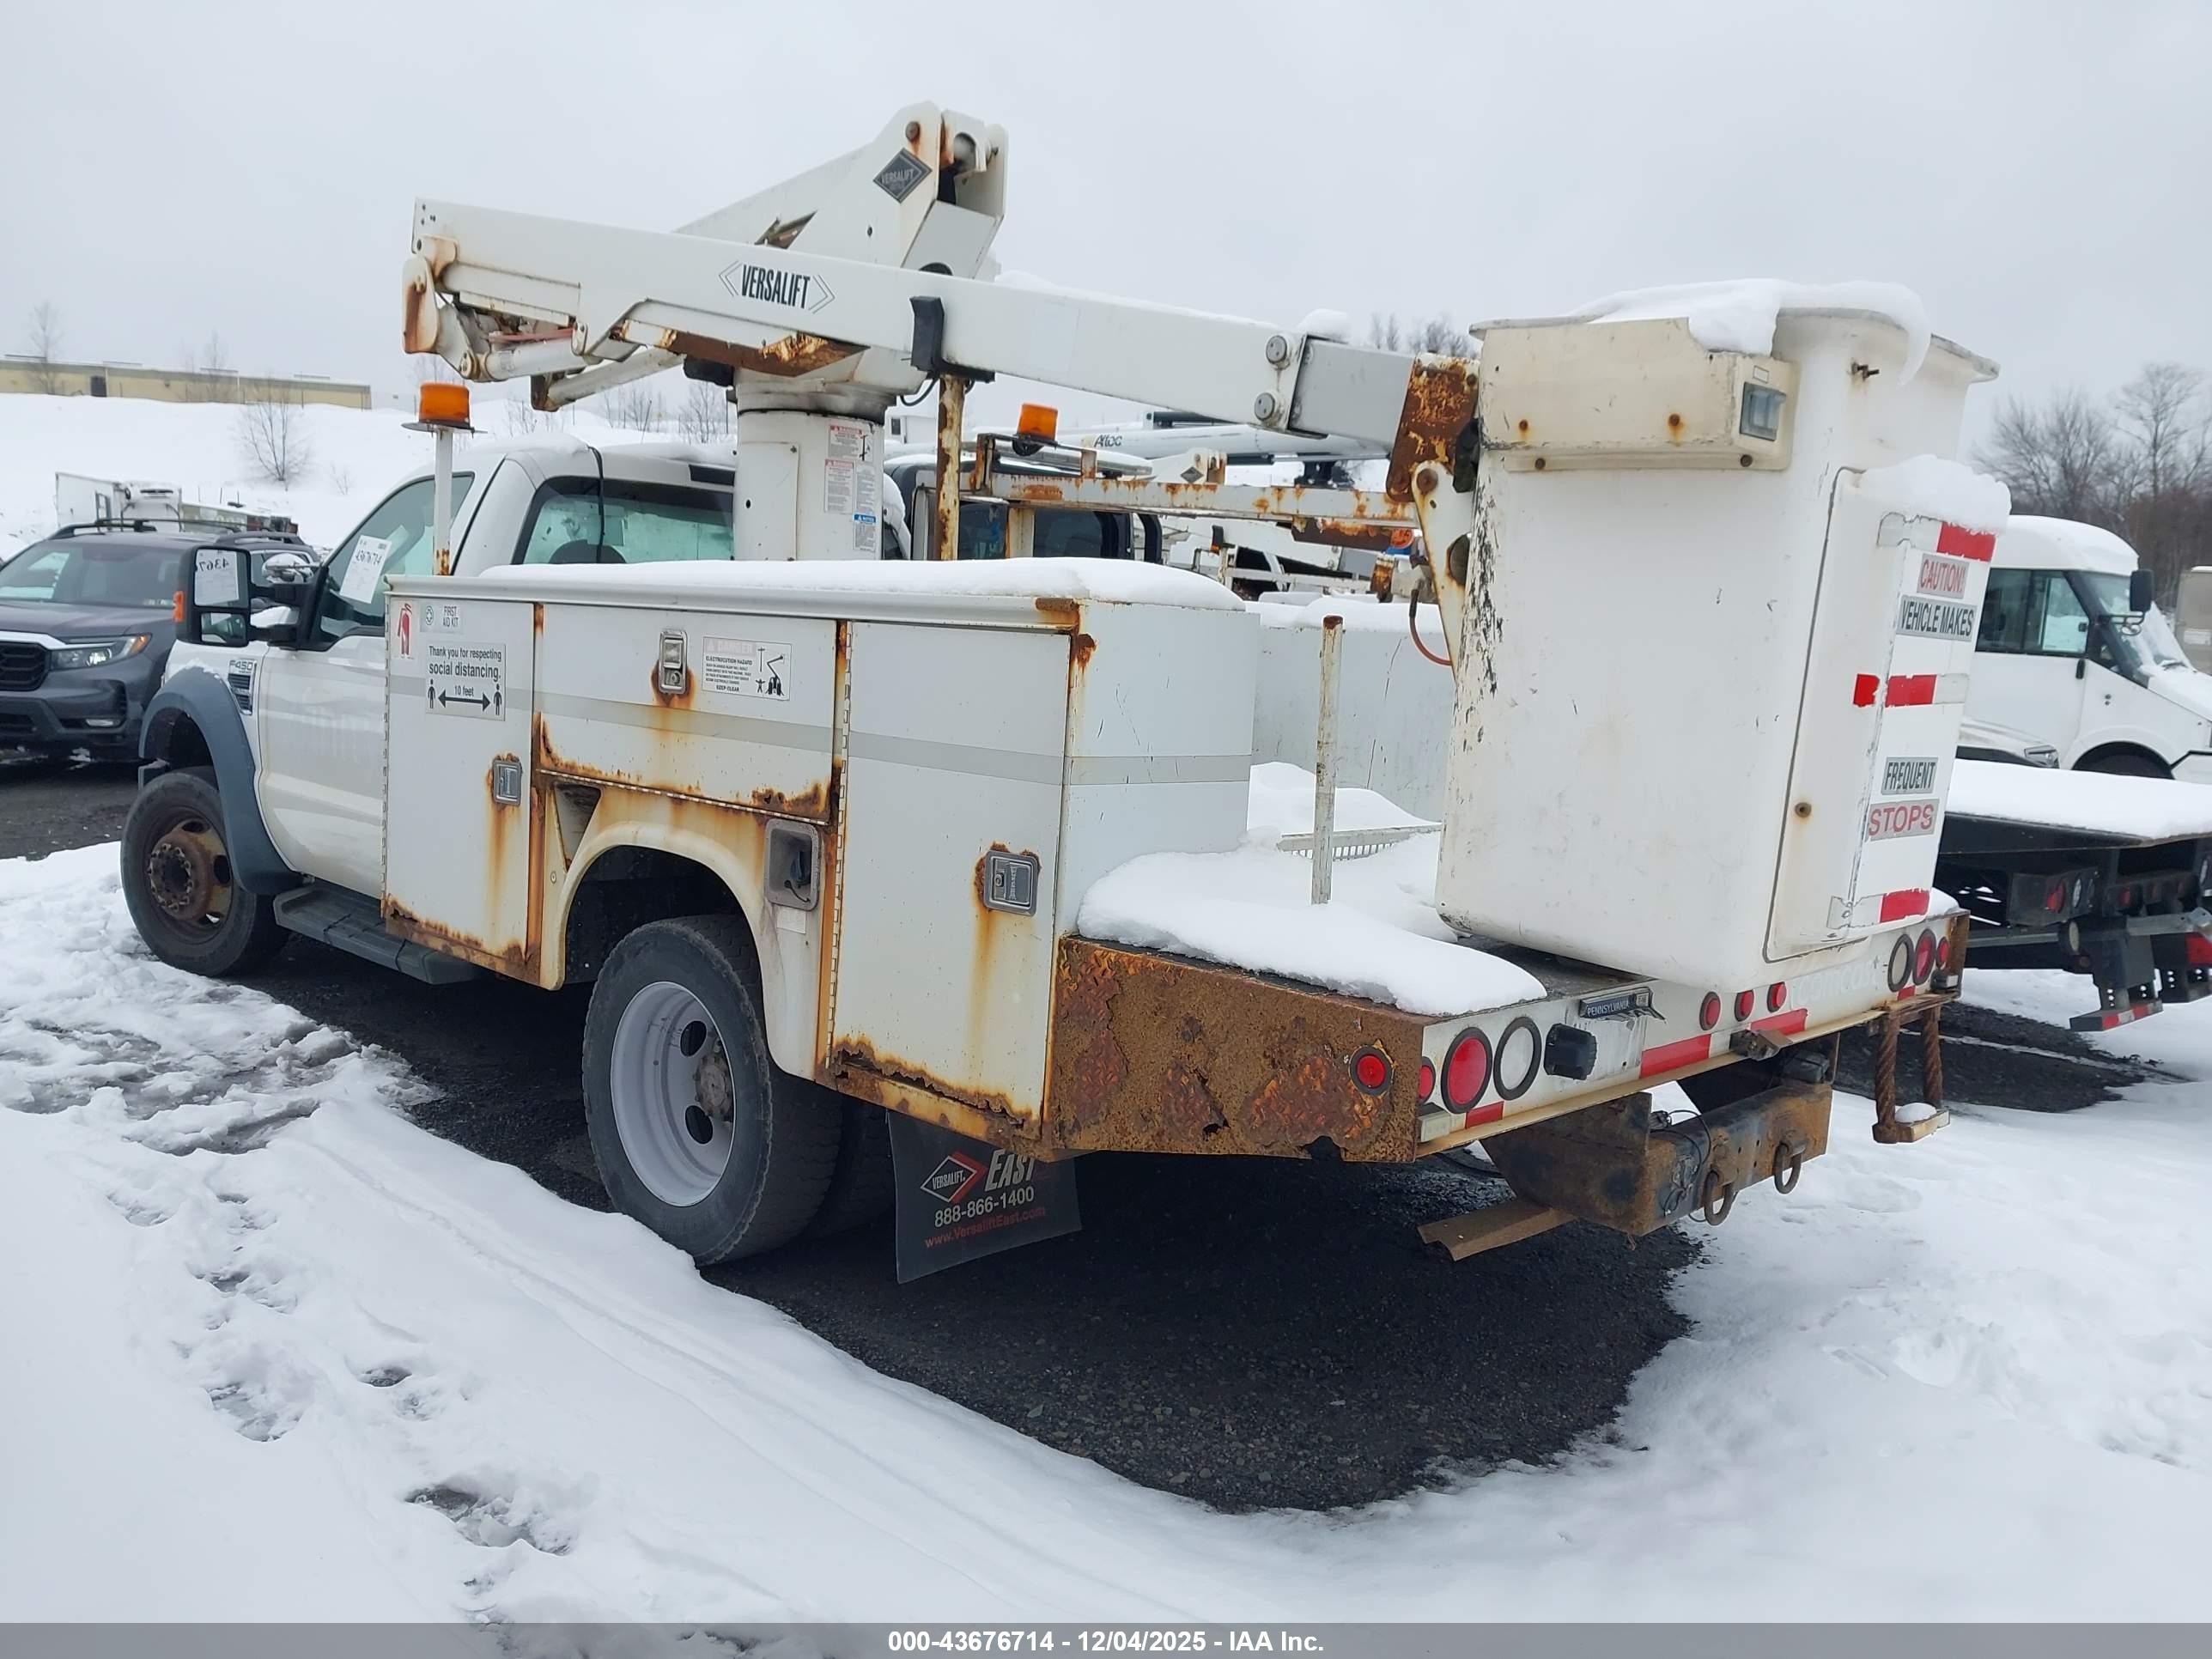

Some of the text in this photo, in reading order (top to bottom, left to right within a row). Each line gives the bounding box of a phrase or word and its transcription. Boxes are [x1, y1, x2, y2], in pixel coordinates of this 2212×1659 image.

[741, 264, 811, 309] VERSALIFT
[1919, 558, 1965, 592] CAUTION!
[444, 605, 457, 617] FIRST
[1901, 599, 1974, 637] VEHICLE MAKES
[429, 646, 501, 662] Thank you for respecting
[429, 660, 501, 682] social distancing.
[454, 685, 474, 696] 10 feet
[1884, 761, 1936, 791] FREQUENT
[1868, 803, 1935, 837] STOPS
[1587, 999, 1630, 1017] PENNSYLVANIA
[932, 1170, 963, 1190] VERSALIFT
[934, 1186, 1035, 1228] 888-866-1400
[924, 1206, 1046, 1248] www.VersaliftEast.com
